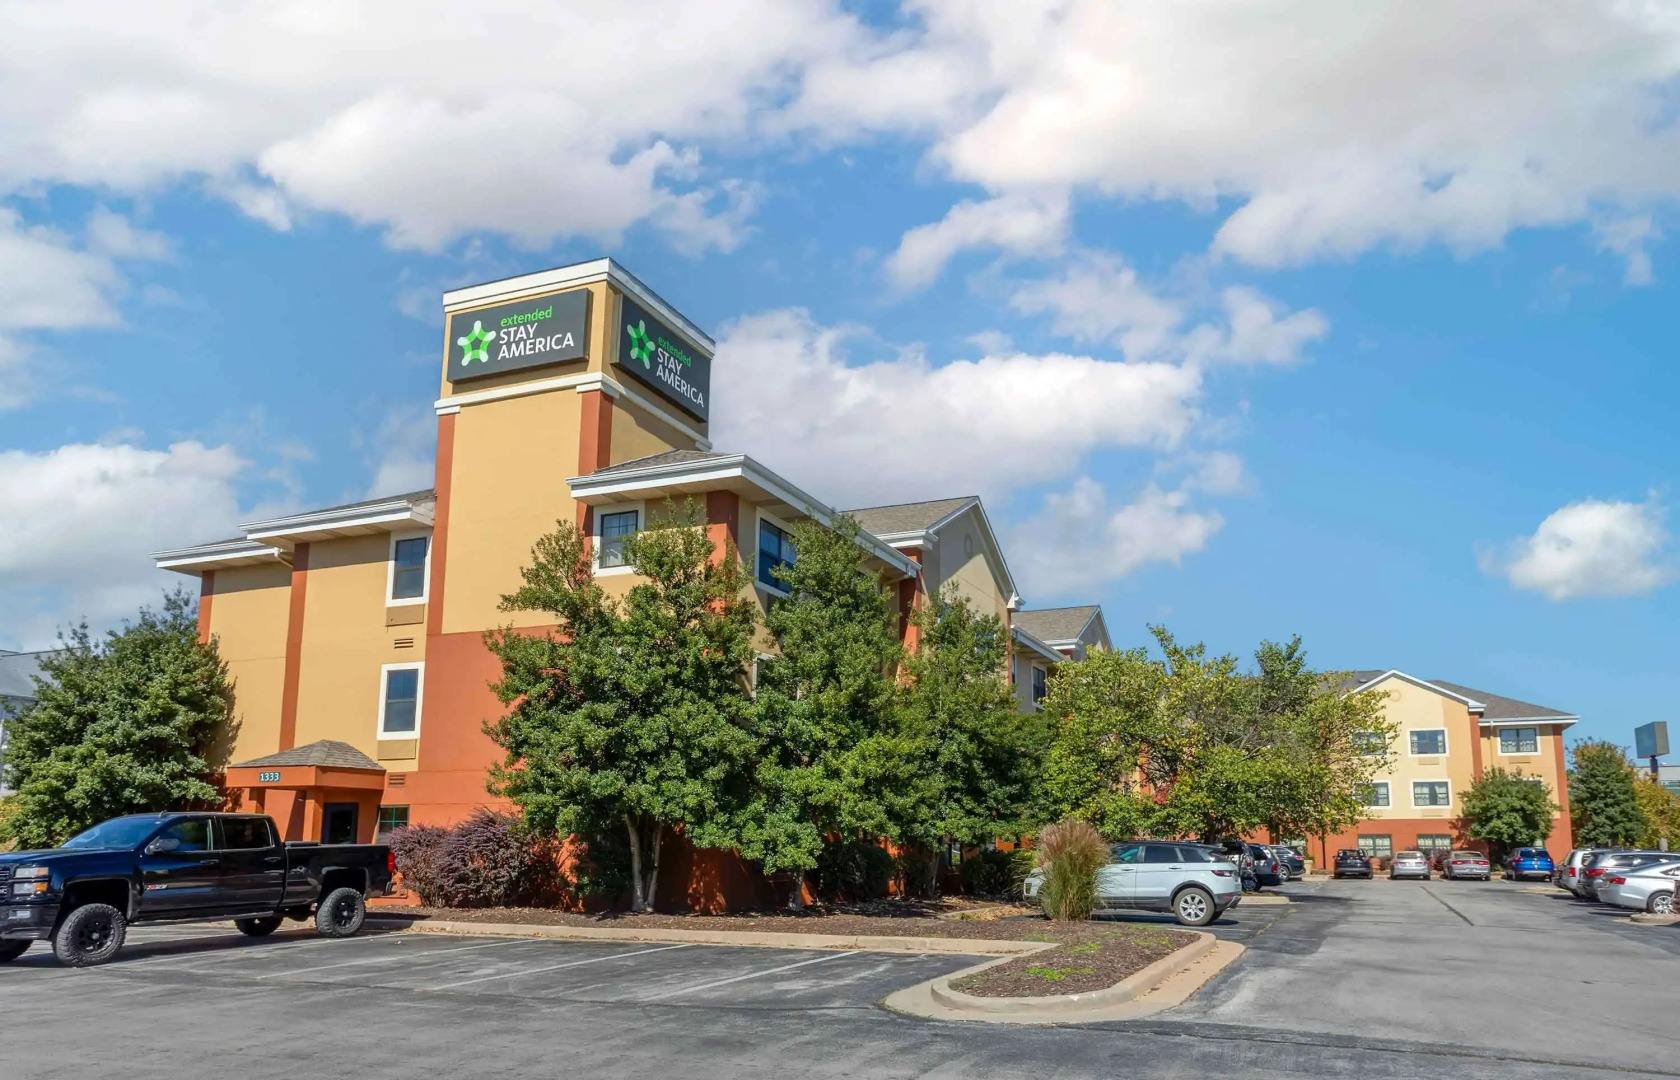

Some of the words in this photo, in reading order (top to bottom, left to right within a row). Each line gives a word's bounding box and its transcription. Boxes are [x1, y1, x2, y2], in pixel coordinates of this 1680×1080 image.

[500, 305, 553, 328] extended
[497, 332, 575, 360] AMERICA
[499, 322, 538, 344] STAY
[657, 347, 683, 375] STAY
[658, 336, 692, 368] extended
[656, 363, 704, 408] AMERICA
[260, 772, 280, 781] 1333
